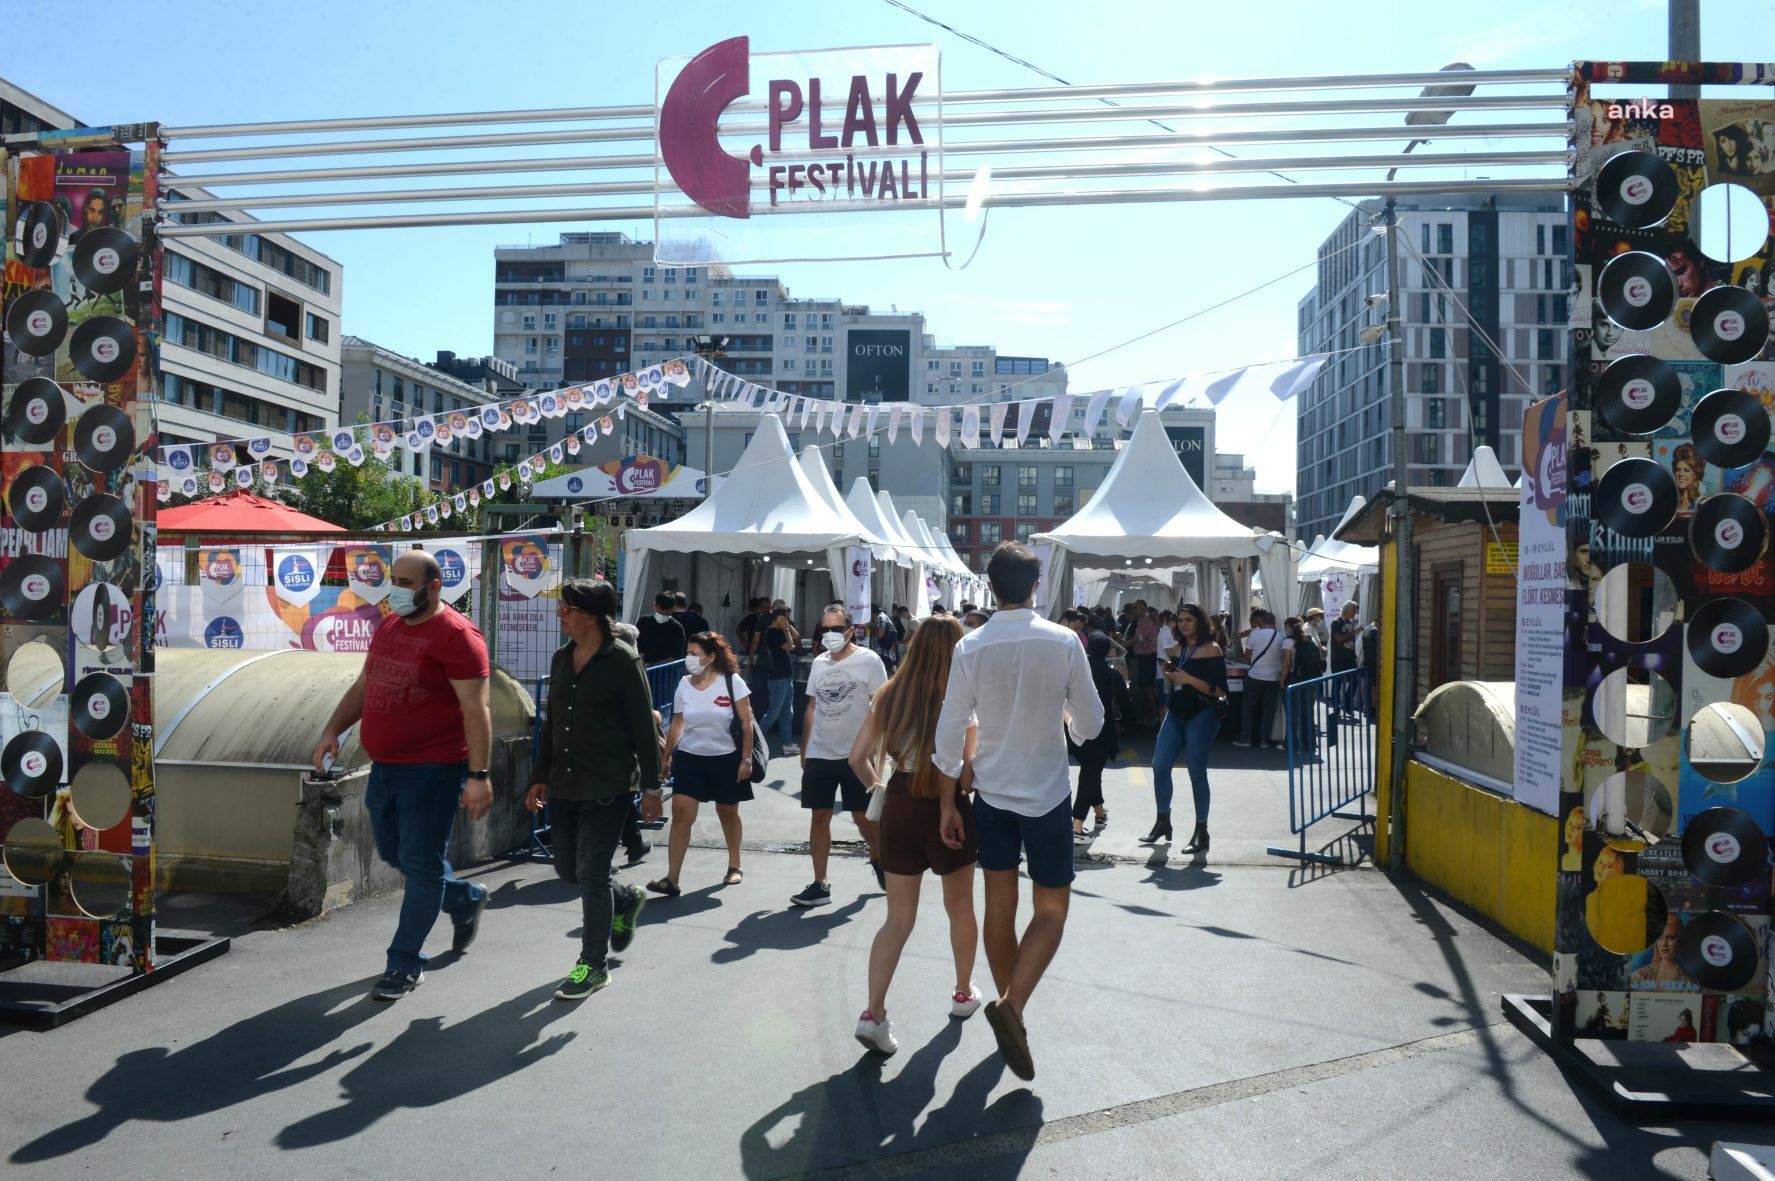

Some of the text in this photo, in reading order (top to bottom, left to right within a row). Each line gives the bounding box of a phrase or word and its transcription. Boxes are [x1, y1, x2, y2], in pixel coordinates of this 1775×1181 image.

[768, 71, 925, 152] PLAK
[1657, 146, 1705, 166] FFSPR
[56, 160, 108, 176] duman
[768, 151, 928, 207] FESTİVALİ
[855, 344, 903, 356] OFTON
[1172, 439, 1202, 452] TON
[1551, 442, 1566, 469] PLA
[633, 468, 655, 480] PLAK
[440, 569, 461, 578] İŞLİ
[334, 619, 371, 638] PLAK
